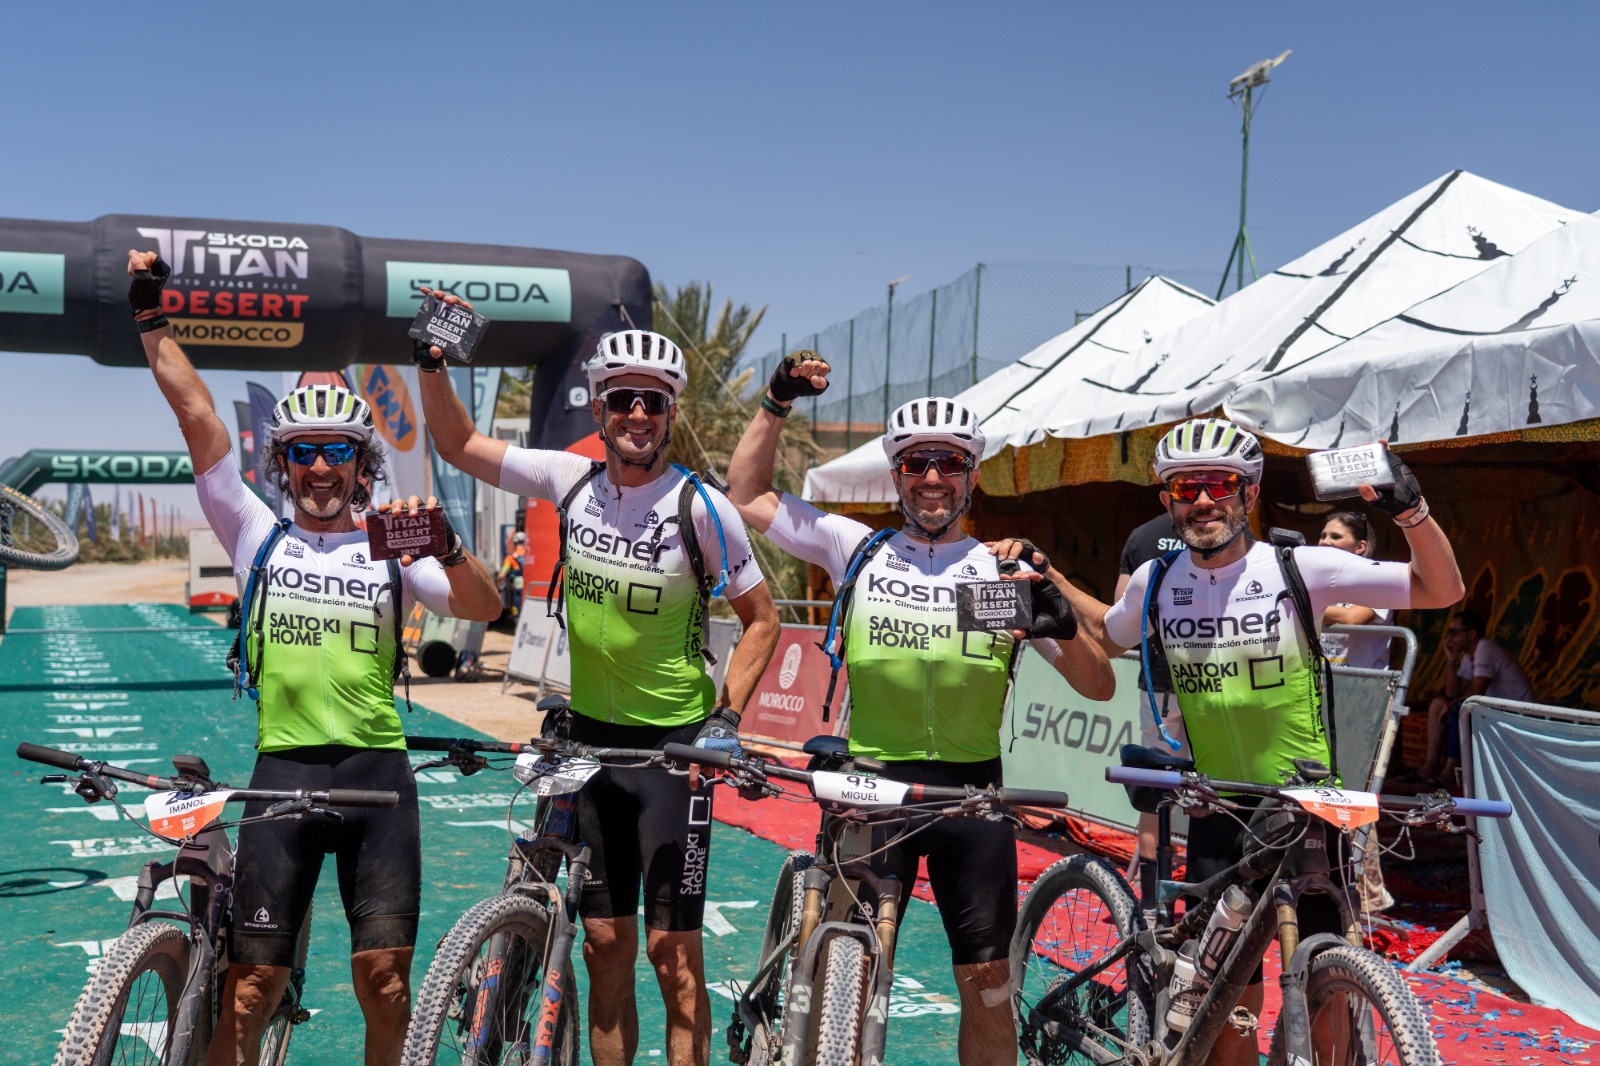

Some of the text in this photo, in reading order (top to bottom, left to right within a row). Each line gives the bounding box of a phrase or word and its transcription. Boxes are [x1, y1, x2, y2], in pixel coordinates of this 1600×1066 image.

[136, 227, 309, 279] TITAN
[0, 271, 39, 294] A
[210, 279, 255, 289] STAGE
[262, 281, 299, 291] RACE
[162, 288, 310, 318] DESERT
[173, 324, 292, 342] MOROCCO
[430, 316, 467, 337] DESERT
[430, 336, 447, 349] 2026
[1320, 450, 1376, 466] TITAN
[1331, 462, 1378, 474] DESERT
[377, 511, 431, 531] TITAN
[386, 527, 432, 540] DESERT
[390, 537, 428, 547] MOROCCO
[629, 563, 665, 575] eficiente
[568, 566, 619, 595] SALTOKI
[568, 583, 604, 605] HOME
[967, 584, 1016, 601] TITAN
[347, 602, 375, 612] eficien
[974, 600, 1017, 610] DESERT
[977, 610, 1013, 618] MOROCCO
[269, 612, 341, 634] SALTOKI
[869, 615, 951, 639] SALTOKI
[986, 620, 1007, 628] 2026
[269, 628, 322, 647] HOME
[869, 631, 930, 650] HOME
[1242, 635, 1281, 646] eficiente
[1171, 661, 1239, 679] SALTOKI
[1177, 678, 1223, 694] HOME
[758, 691, 805, 713] MOROCCO
[846, 775, 878, 790] 95
[841, 790, 880, 802] MIGUEL
[1320, 796, 1352, 804] DIEGO
[169, 798, 205, 815] IMANOL
[680, 833, 700, 896] SALTOKI
[692, 847, 707, 895] HOME
